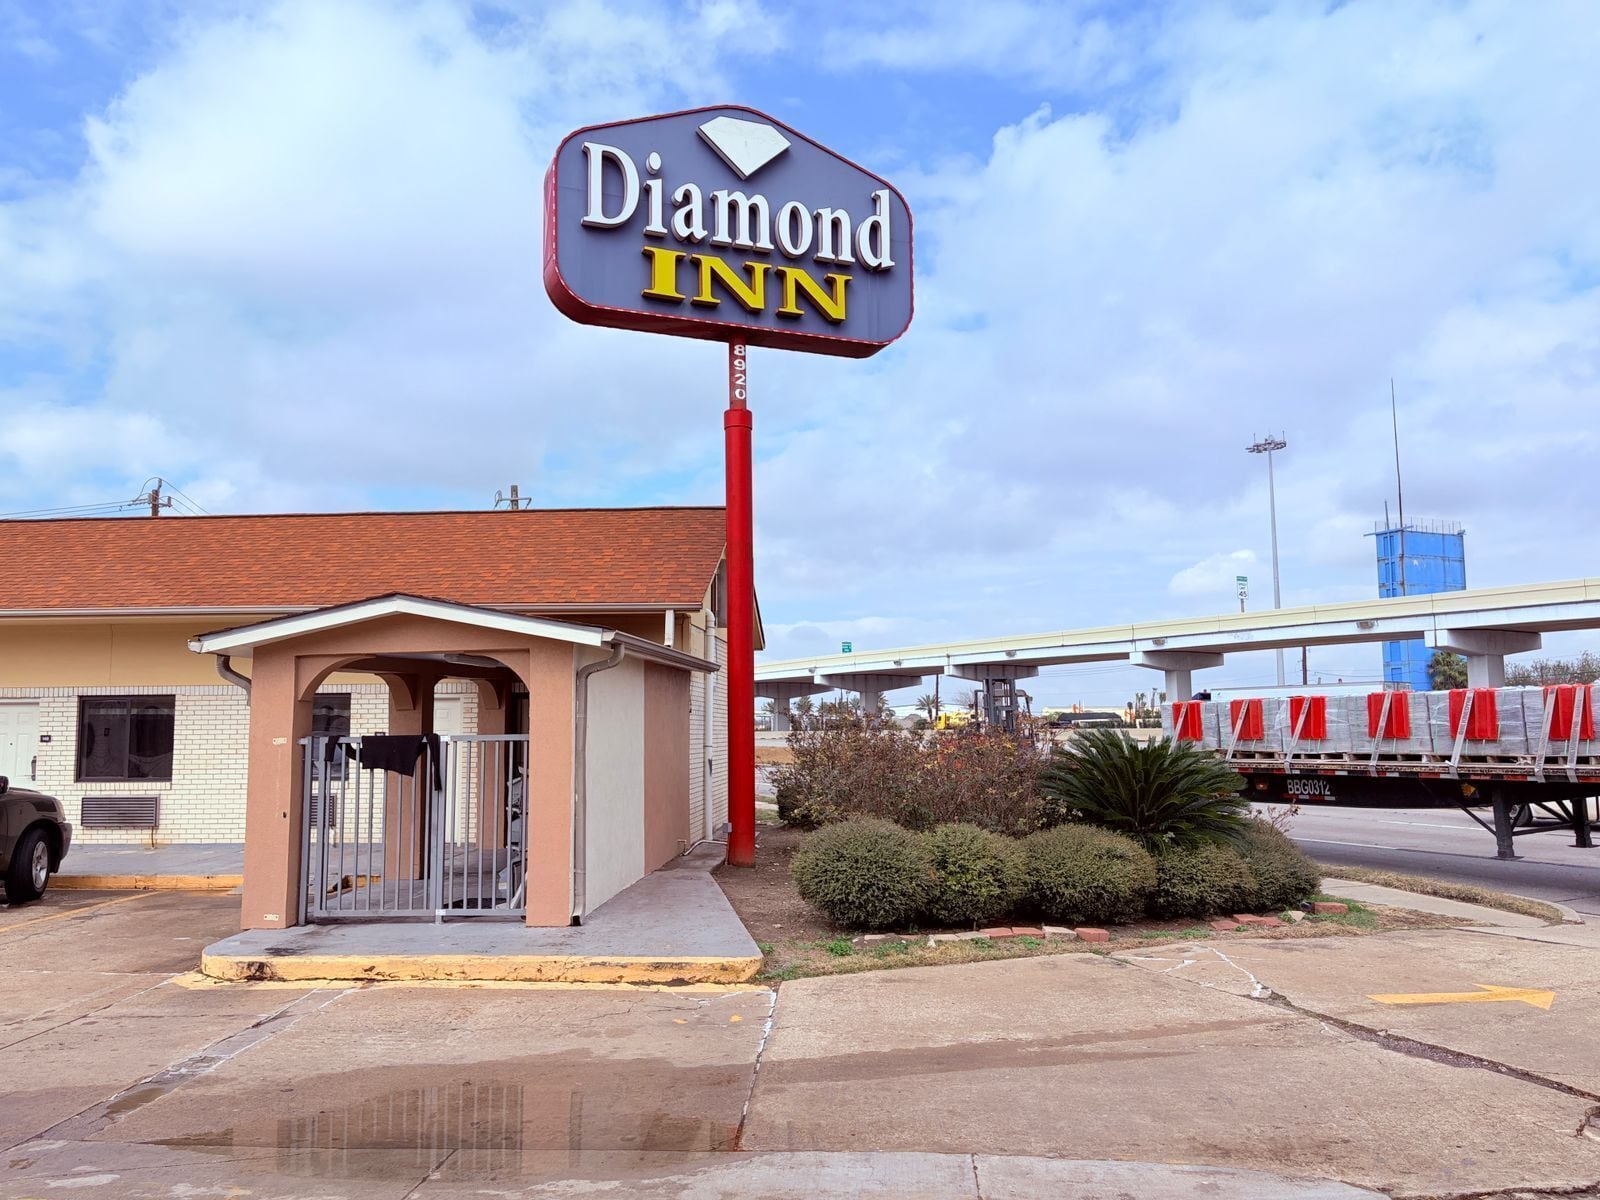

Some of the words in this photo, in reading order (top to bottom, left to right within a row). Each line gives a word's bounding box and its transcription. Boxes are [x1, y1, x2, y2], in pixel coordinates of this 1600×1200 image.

[582, 142, 895, 271] Diamond
[641, 246, 853, 323] INN
[733, 344, 746, 400] 8920
[1287, 779, 1331, 795] BBG0312
